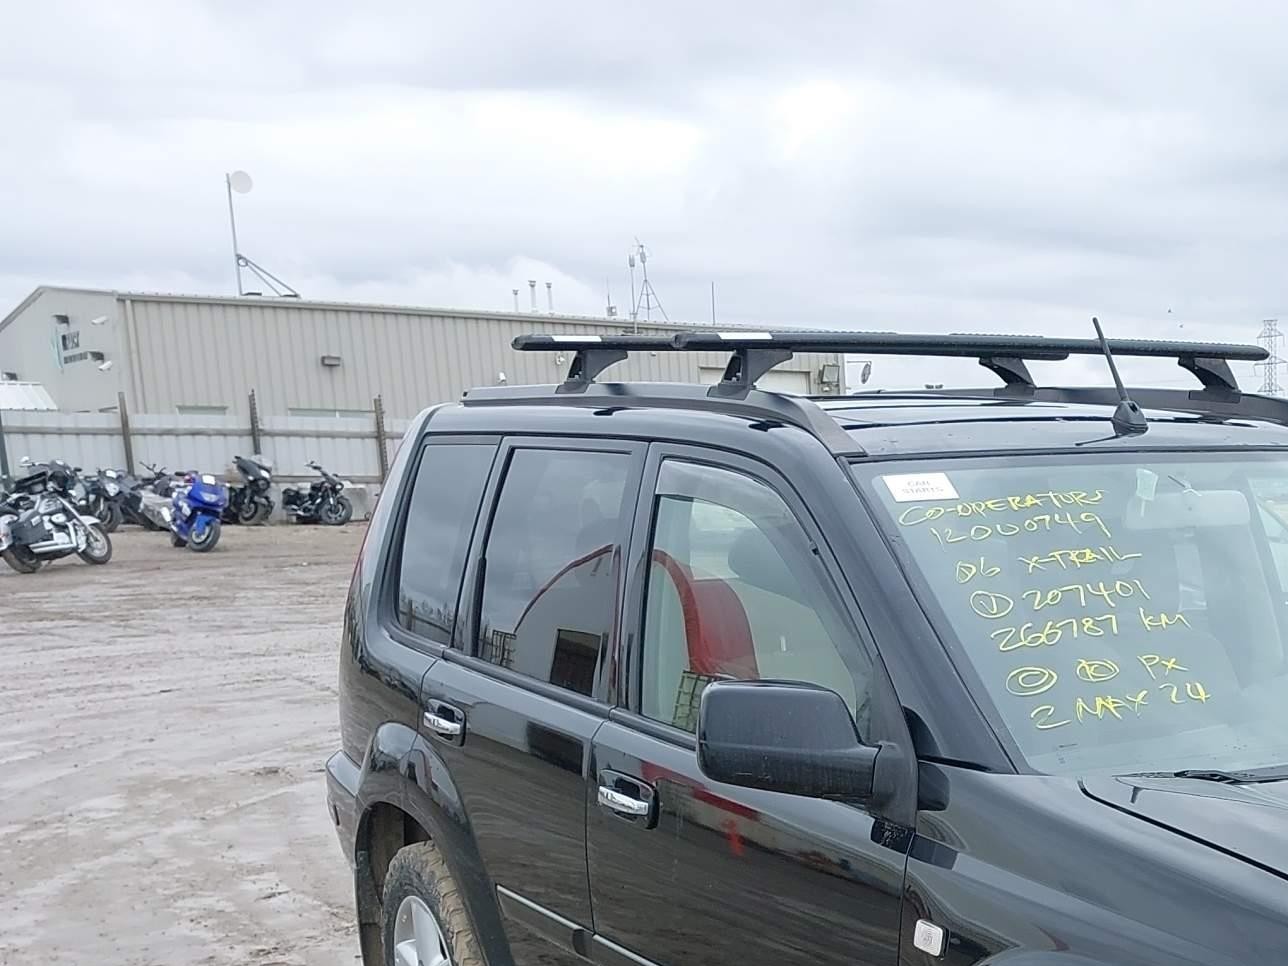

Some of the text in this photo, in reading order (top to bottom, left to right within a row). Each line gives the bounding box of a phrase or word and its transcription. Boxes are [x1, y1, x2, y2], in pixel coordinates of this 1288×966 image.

[930, 511, 1112, 546] 12000749
[1022, 578, 1151, 611] 207401
[990, 614, 1119, 652] 266787
[1158, 681, 1212, 704] 24
